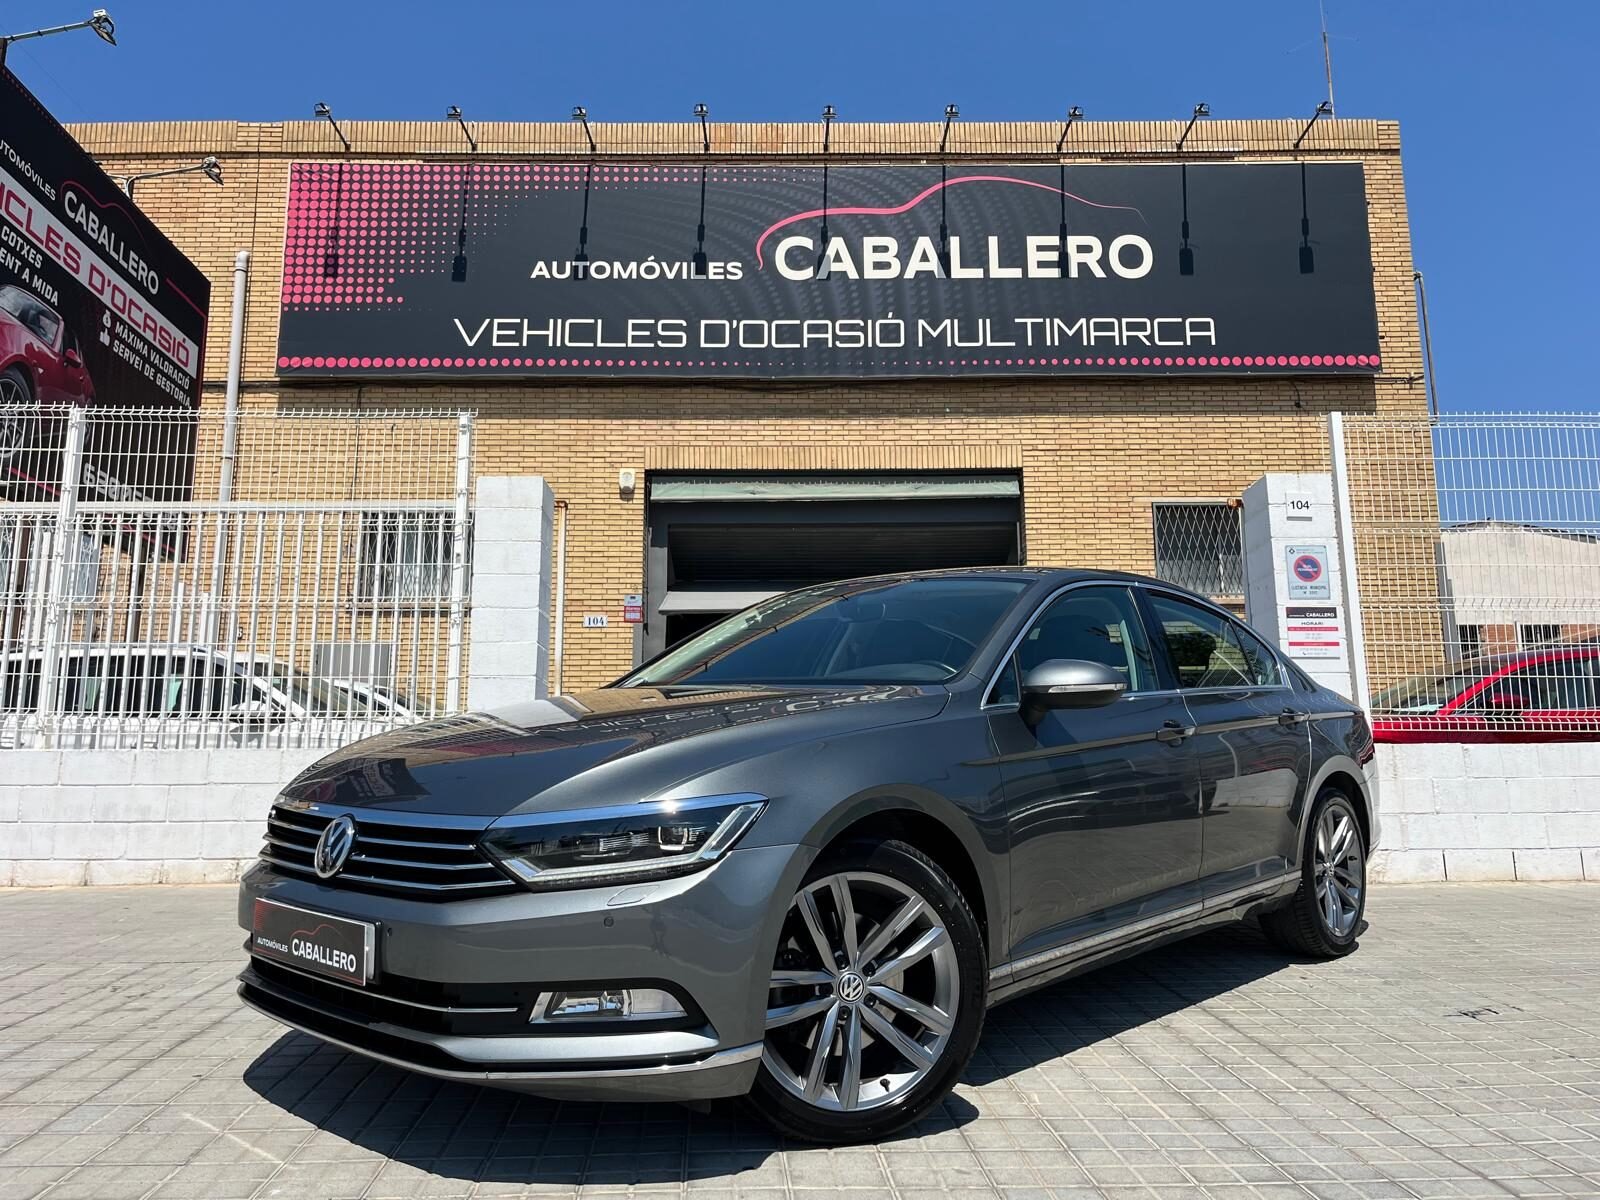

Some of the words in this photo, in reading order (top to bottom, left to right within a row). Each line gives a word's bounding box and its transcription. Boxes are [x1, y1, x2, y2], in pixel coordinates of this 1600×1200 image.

[1, 225, 43, 269] COTXES
[64, 190, 159, 295] CABALLERO
[530, 255, 743, 280] AUTOMÓVILES
[774, 234, 1155, 281] CABALLERO
[22, 267, 30, 283] A
[32, 274, 59, 307] MIDA
[88, 261, 191, 369] D'OCASIÓ
[453, 317, 687, 349] VEHICLES
[700, 311, 905, 349] D'OCASIÓ
[918, 317, 1217, 347] MULTIMARCA
[113, 339, 143, 369] SERVEI
[144, 364, 155, 380] DE
[155, 371, 192, 408] GESTORIA
[115, 320, 149, 359] MÀXIMA
[150, 348, 190, 389] VALORACIÓ
[1289, 500, 1310, 510] 104
[588, 616, 604, 626] 104
[257, 936, 289, 953] AUTOMÓVILES
[291, 938, 357, 973] CABALLERO
